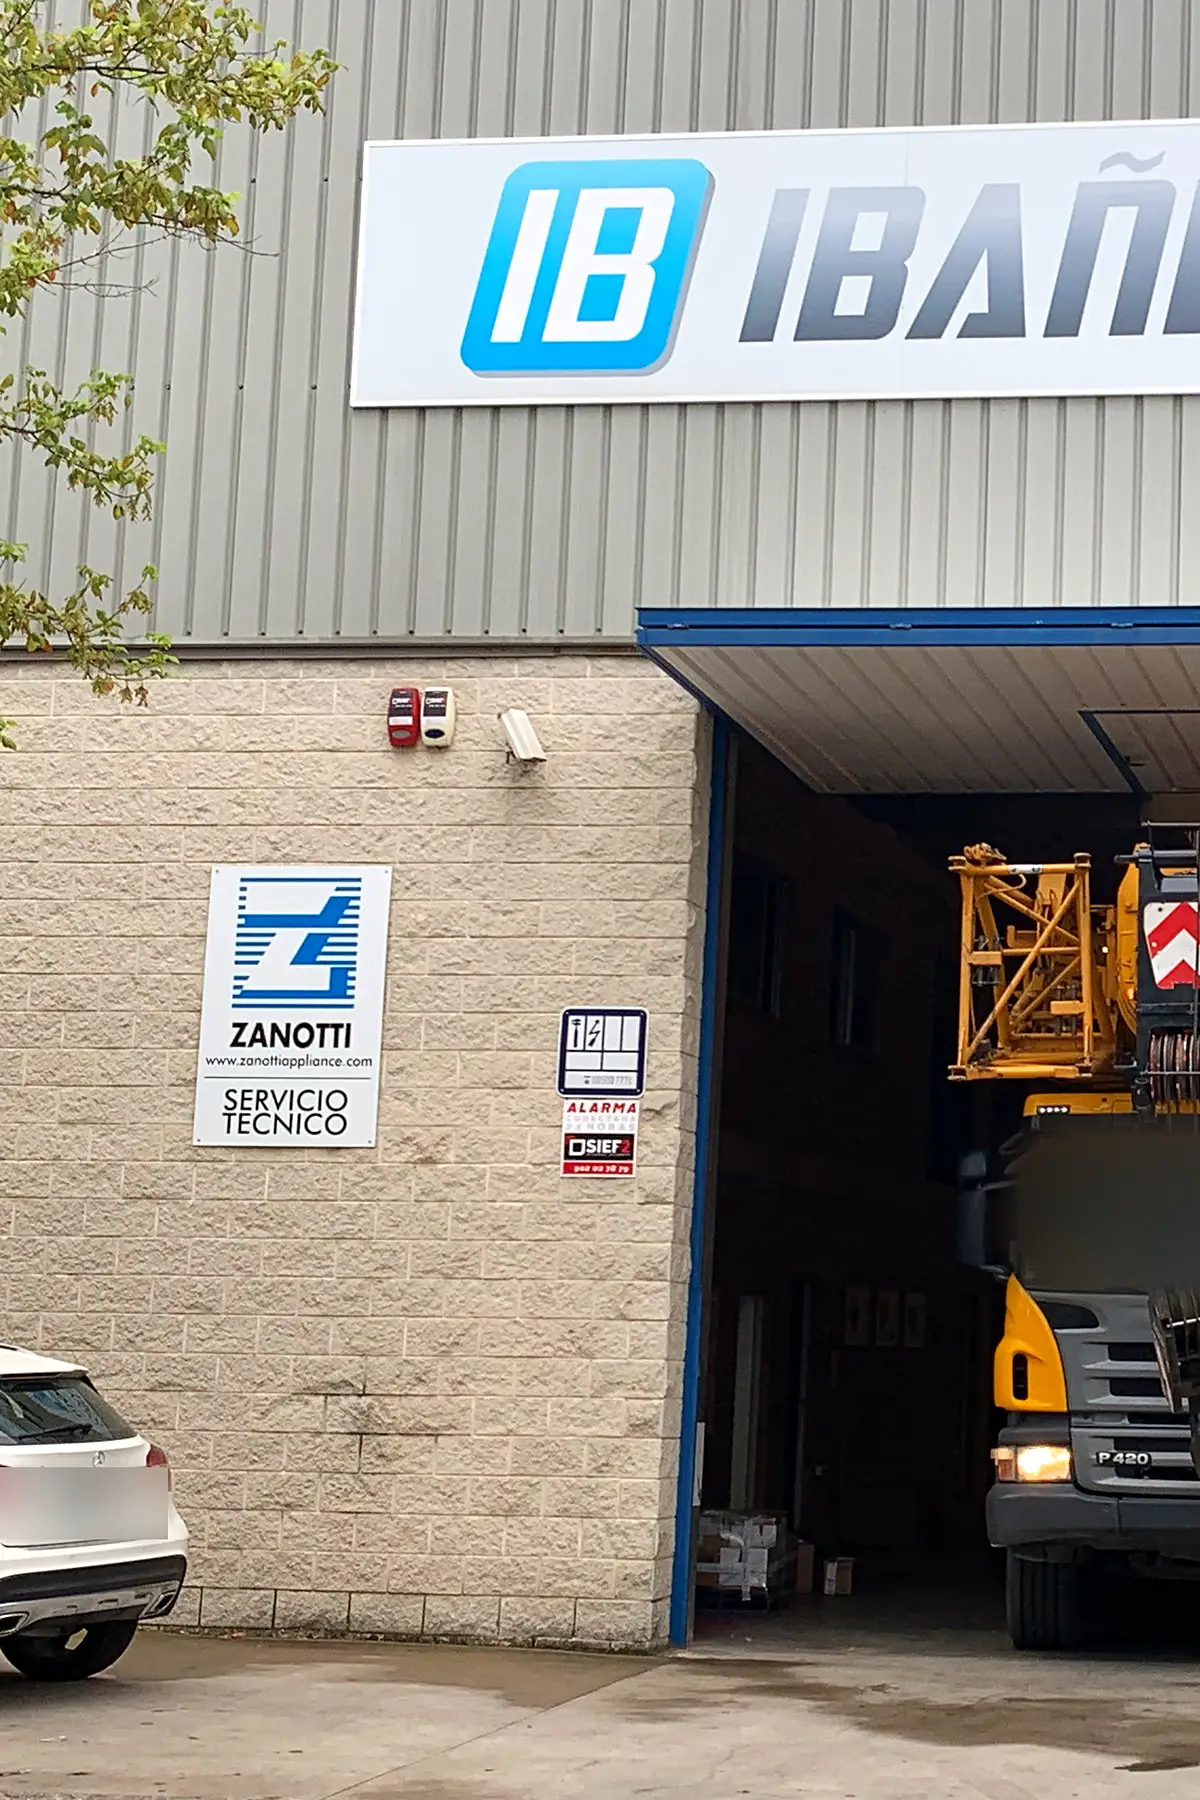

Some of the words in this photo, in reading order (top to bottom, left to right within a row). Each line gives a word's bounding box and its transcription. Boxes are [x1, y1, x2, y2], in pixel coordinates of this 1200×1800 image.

[490, 186, 676, 344] IB
[229, 1022, 352, 1049] ZANOTTI
[205, 1054, 373, 1070] www.zanottiappliance.com
[223, 1088, 348, 1112] SERVICIO
[567, 1102, 637, 1114] ALARMA
[222, 1112, 348, 1136] TECNICO
[1098, 1452, 1111, 1464] P
[1112, 1452, 1149, 1465] 420
